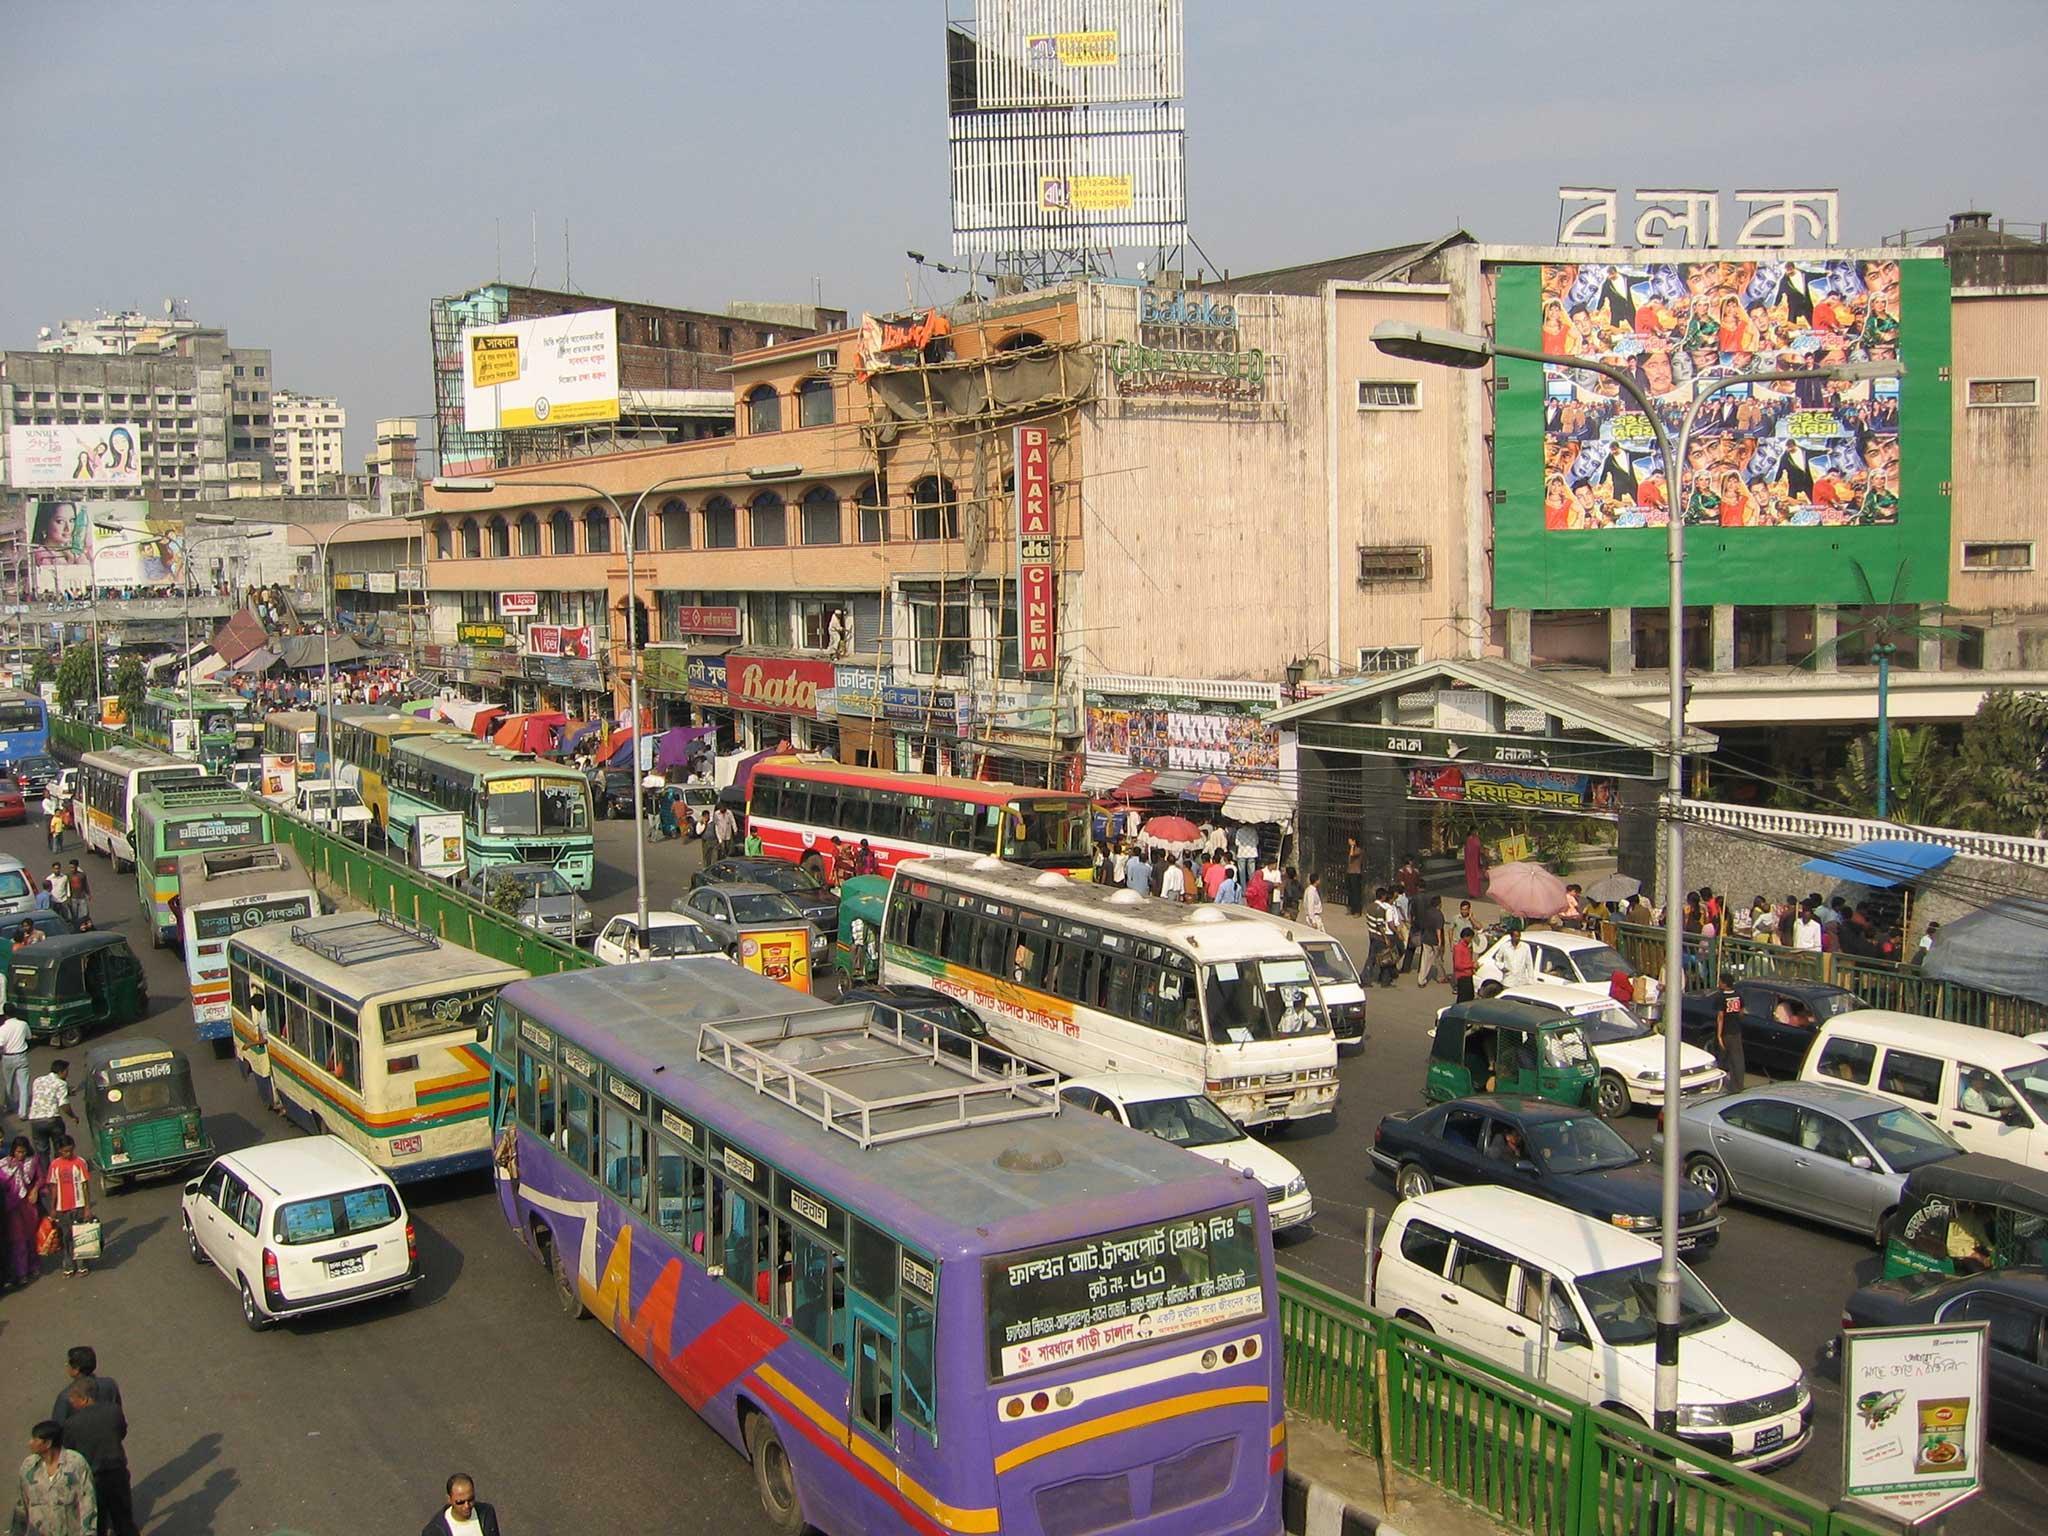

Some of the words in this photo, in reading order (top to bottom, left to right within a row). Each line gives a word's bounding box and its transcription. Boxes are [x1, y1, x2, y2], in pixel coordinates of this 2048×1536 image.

[1558, 187, 1839, 247] বলাকা
[1142, 290, 1237, 326] Balaka
[1027, 431, 1044, 531] BALAKA
[1022, 541, 1051, 557] dts
[1029, 568, 1047, 667] CINEMA
[741, 663, 817, 710] Bata
[1387, 736, 1422, 752] বলাকা
[793, 1192, 826, 1226] শাহবাগ
[1209, 1216, 1235, 1243] লিঃ
[1130, 1265, 1166, 1290] ৬৩
[1037, 1339, 1074, 1361] সাবধানে
[1076, 1328, 1100, 1352] গাড়ী
[1103, 1323, 1135, 1343] চালান
